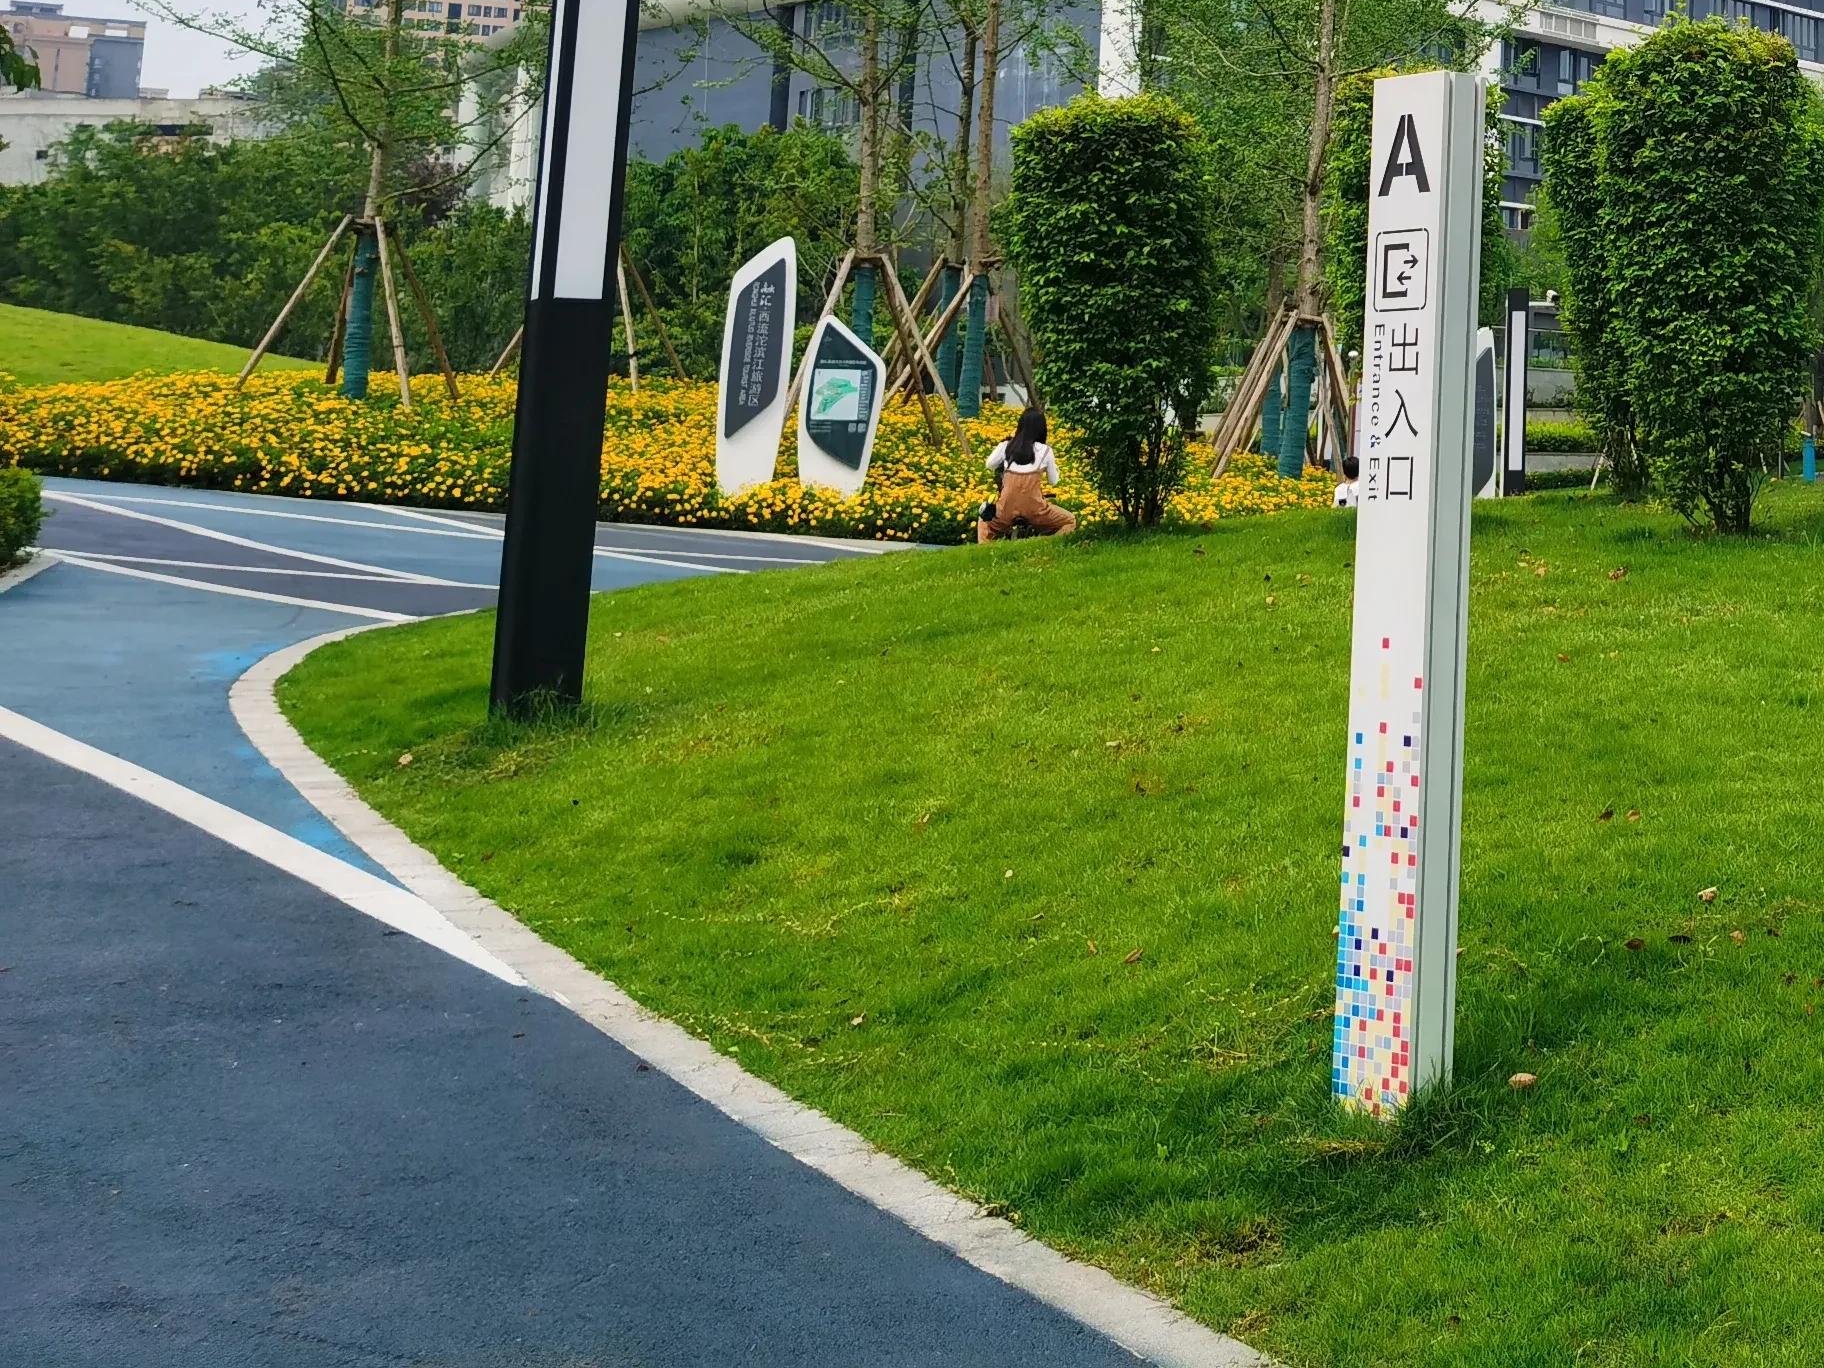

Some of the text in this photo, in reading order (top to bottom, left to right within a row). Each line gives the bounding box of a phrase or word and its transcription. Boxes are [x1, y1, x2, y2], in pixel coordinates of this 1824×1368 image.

[1378, 113, 1430, 197] A
[1367, 323, 1385, 501] Entrance & Exit
[1384, 322, 1419, 500] 出入口
